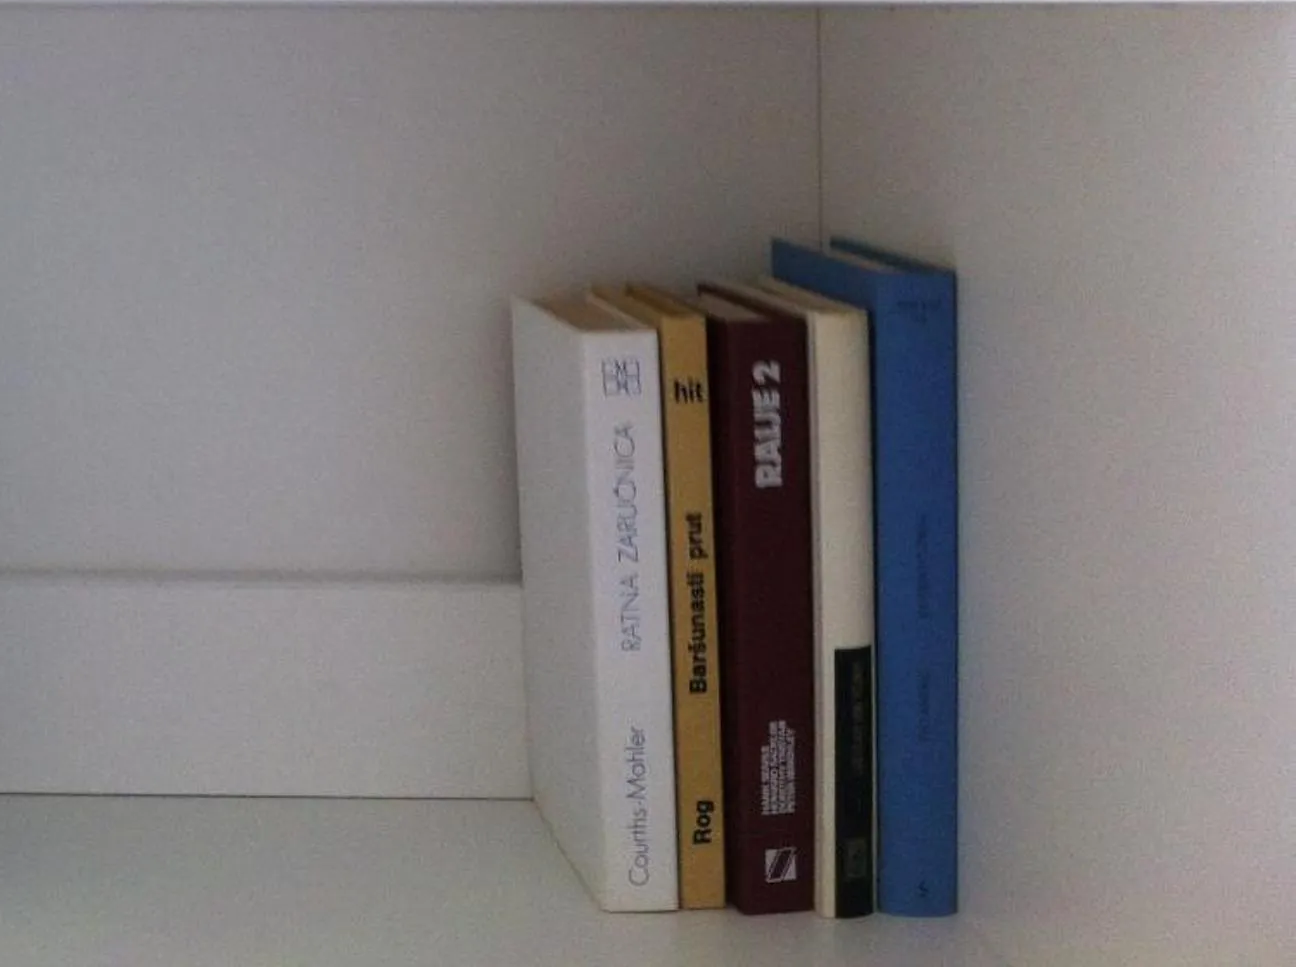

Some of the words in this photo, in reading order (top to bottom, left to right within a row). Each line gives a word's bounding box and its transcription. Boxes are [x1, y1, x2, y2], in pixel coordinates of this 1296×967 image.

[673, 377, 704, 404] hit
[752, 360, 781, 385] 2
[686, 512, 708, 560] prut
[619, 572, 642, 651] RATNA
[687, 573, 707, 694] Baršunasti
[693, 800, 714, 845] Rog
